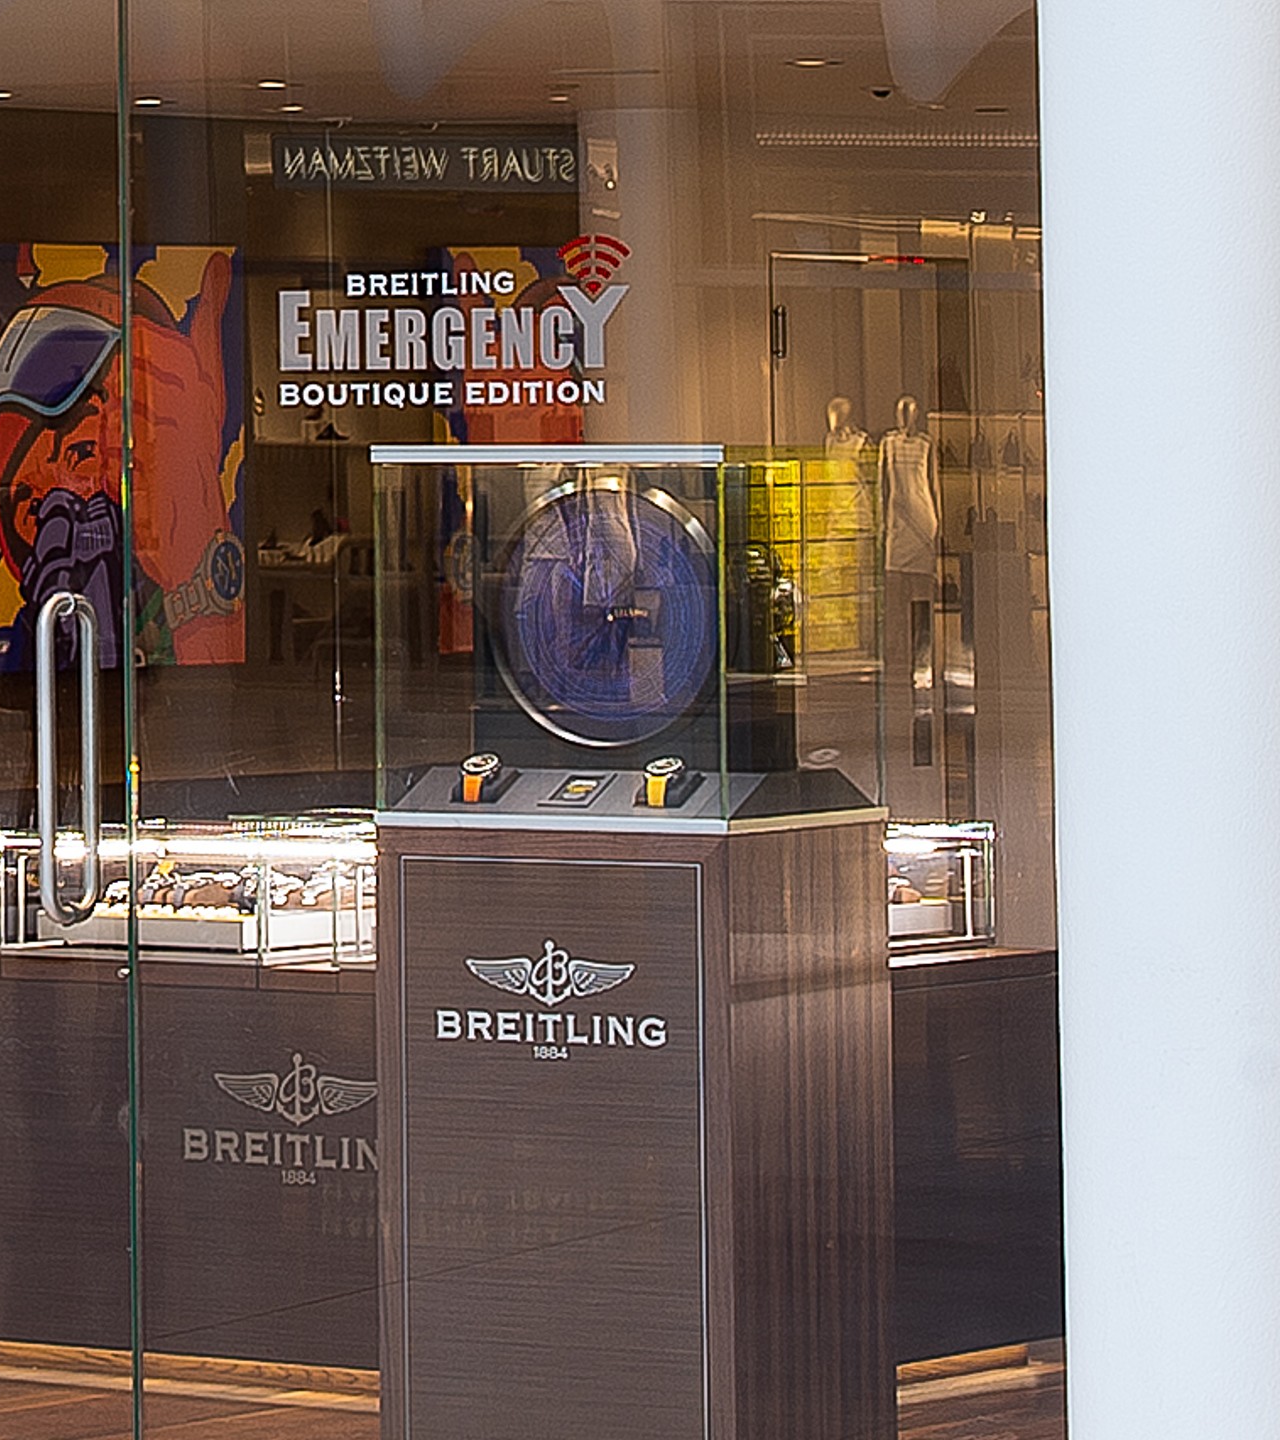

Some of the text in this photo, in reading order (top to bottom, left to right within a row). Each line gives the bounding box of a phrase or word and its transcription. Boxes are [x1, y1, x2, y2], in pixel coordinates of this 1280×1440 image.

[345, 271, 515, 297] BREITLING
[278, 284, 631, 371] EMERGENCY
[279, 380, 606, 406] BOUTIQUE EDITION
[436, 1010, 668, 1048] BREITLING
[533, 1045, 569, 1060] 1884
[182, 1128, 379, 1171] BREITLIN
[281, 1169, 317, 1186] 1884
